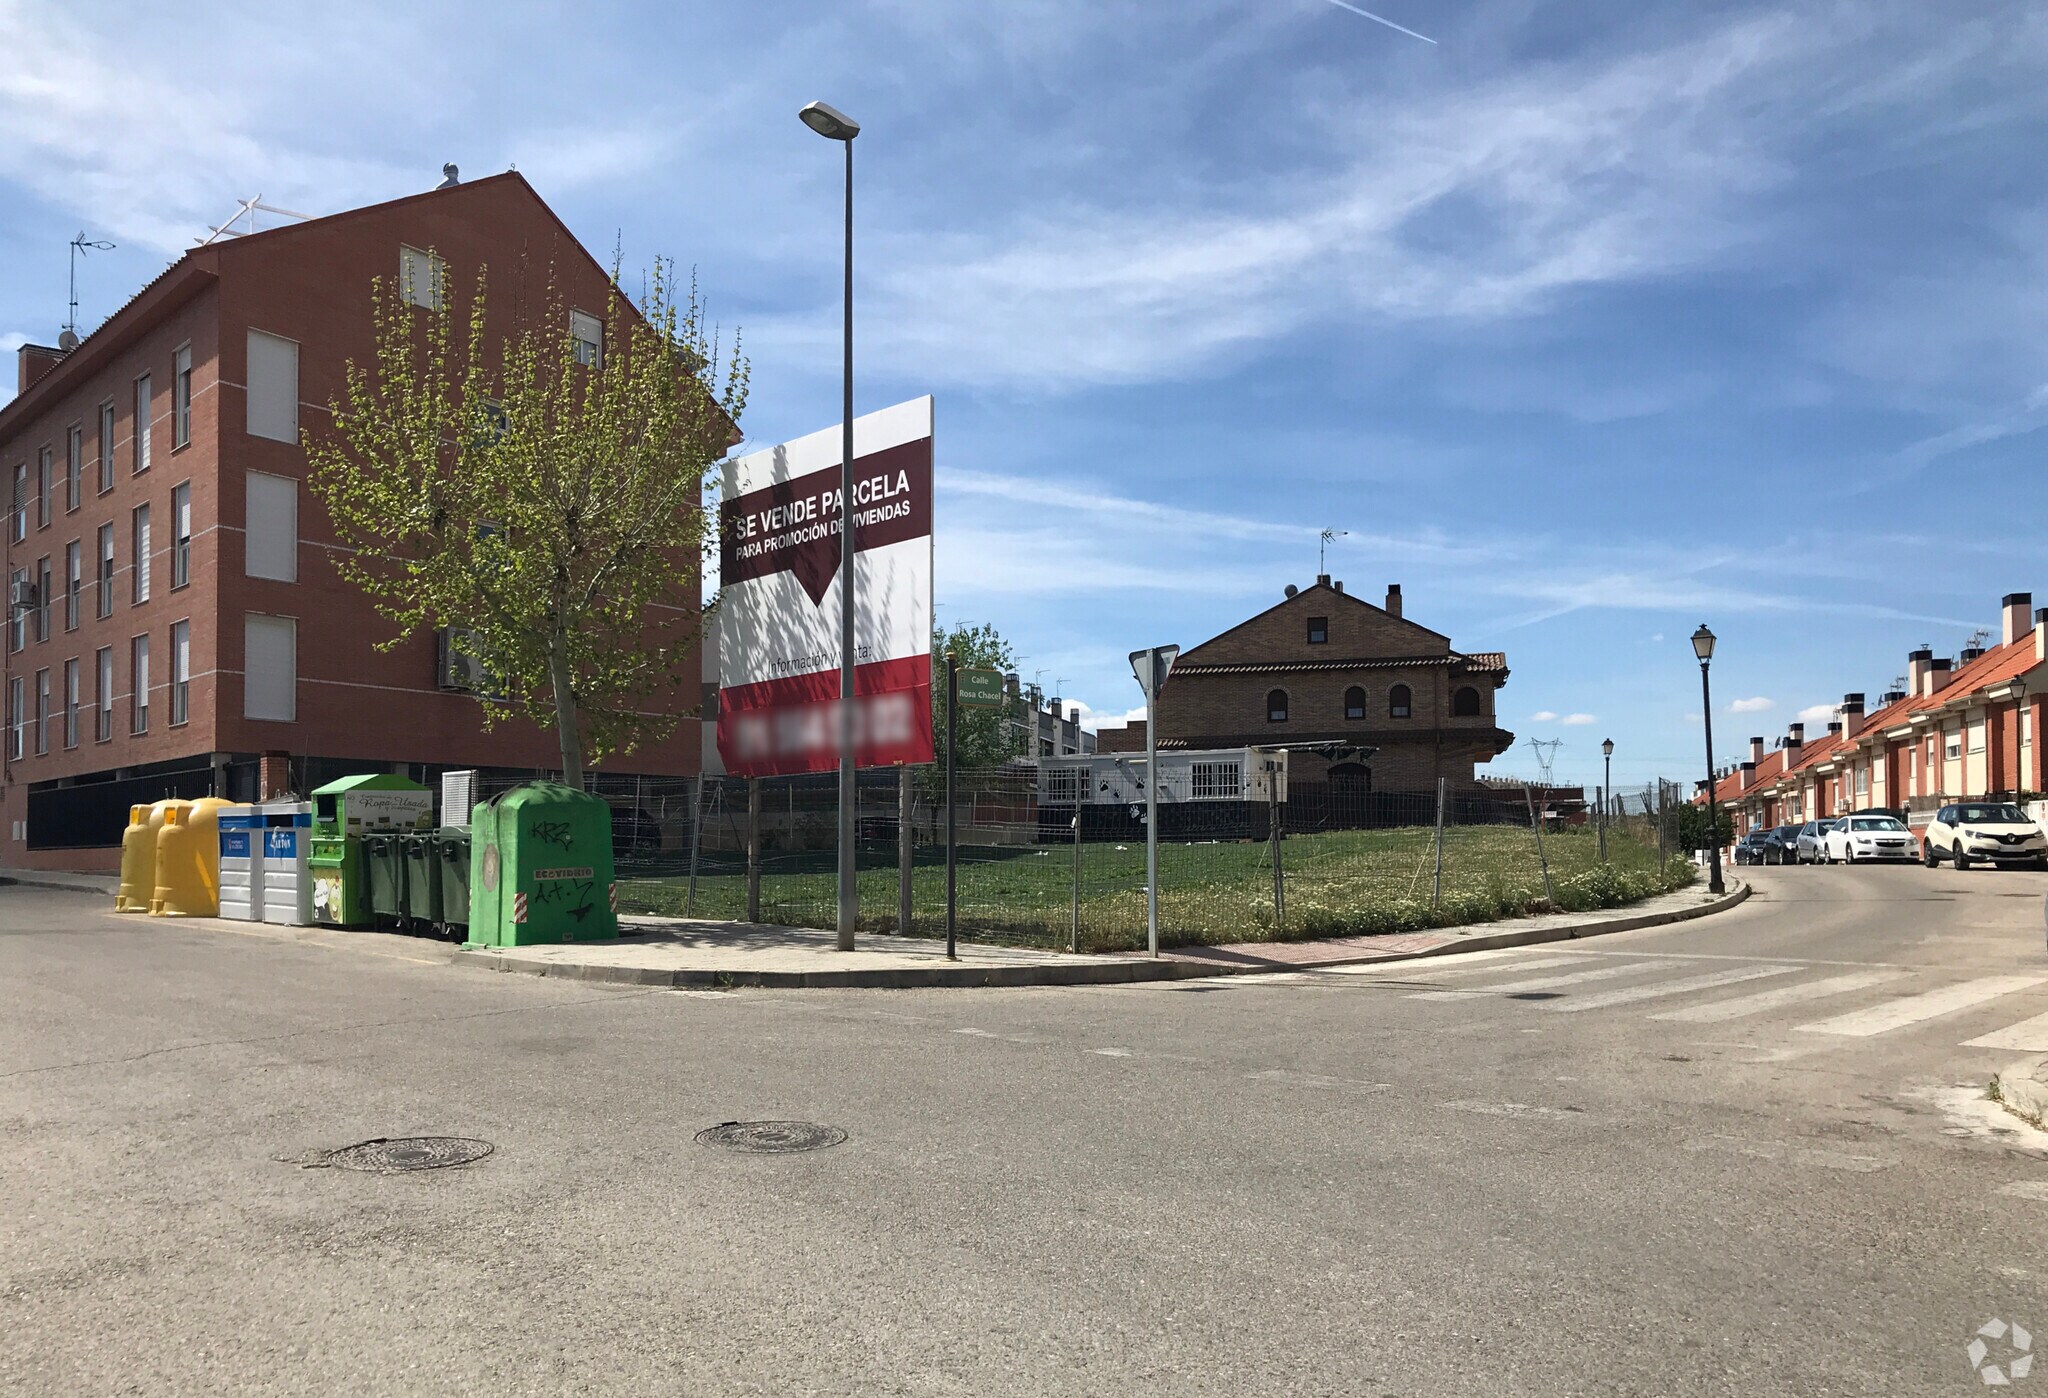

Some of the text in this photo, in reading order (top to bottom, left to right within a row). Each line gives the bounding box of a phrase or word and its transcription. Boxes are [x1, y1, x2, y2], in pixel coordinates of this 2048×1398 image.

[736, 514, 757, 541] SE
[760, 496, 817, 533] VENDE
[736, 541, 763, 561] PARA
[764, 522, 828, 553] PROMOCIÓN
[830, 518, 844, 535] DE
[768, 645, 872, 674] Información y nta:
[971, 676, 989, 685] Calle
[959, 690, 1001, 700] Rosa Chacel
[535, 868, 592, 879] ECOVIDRIO
